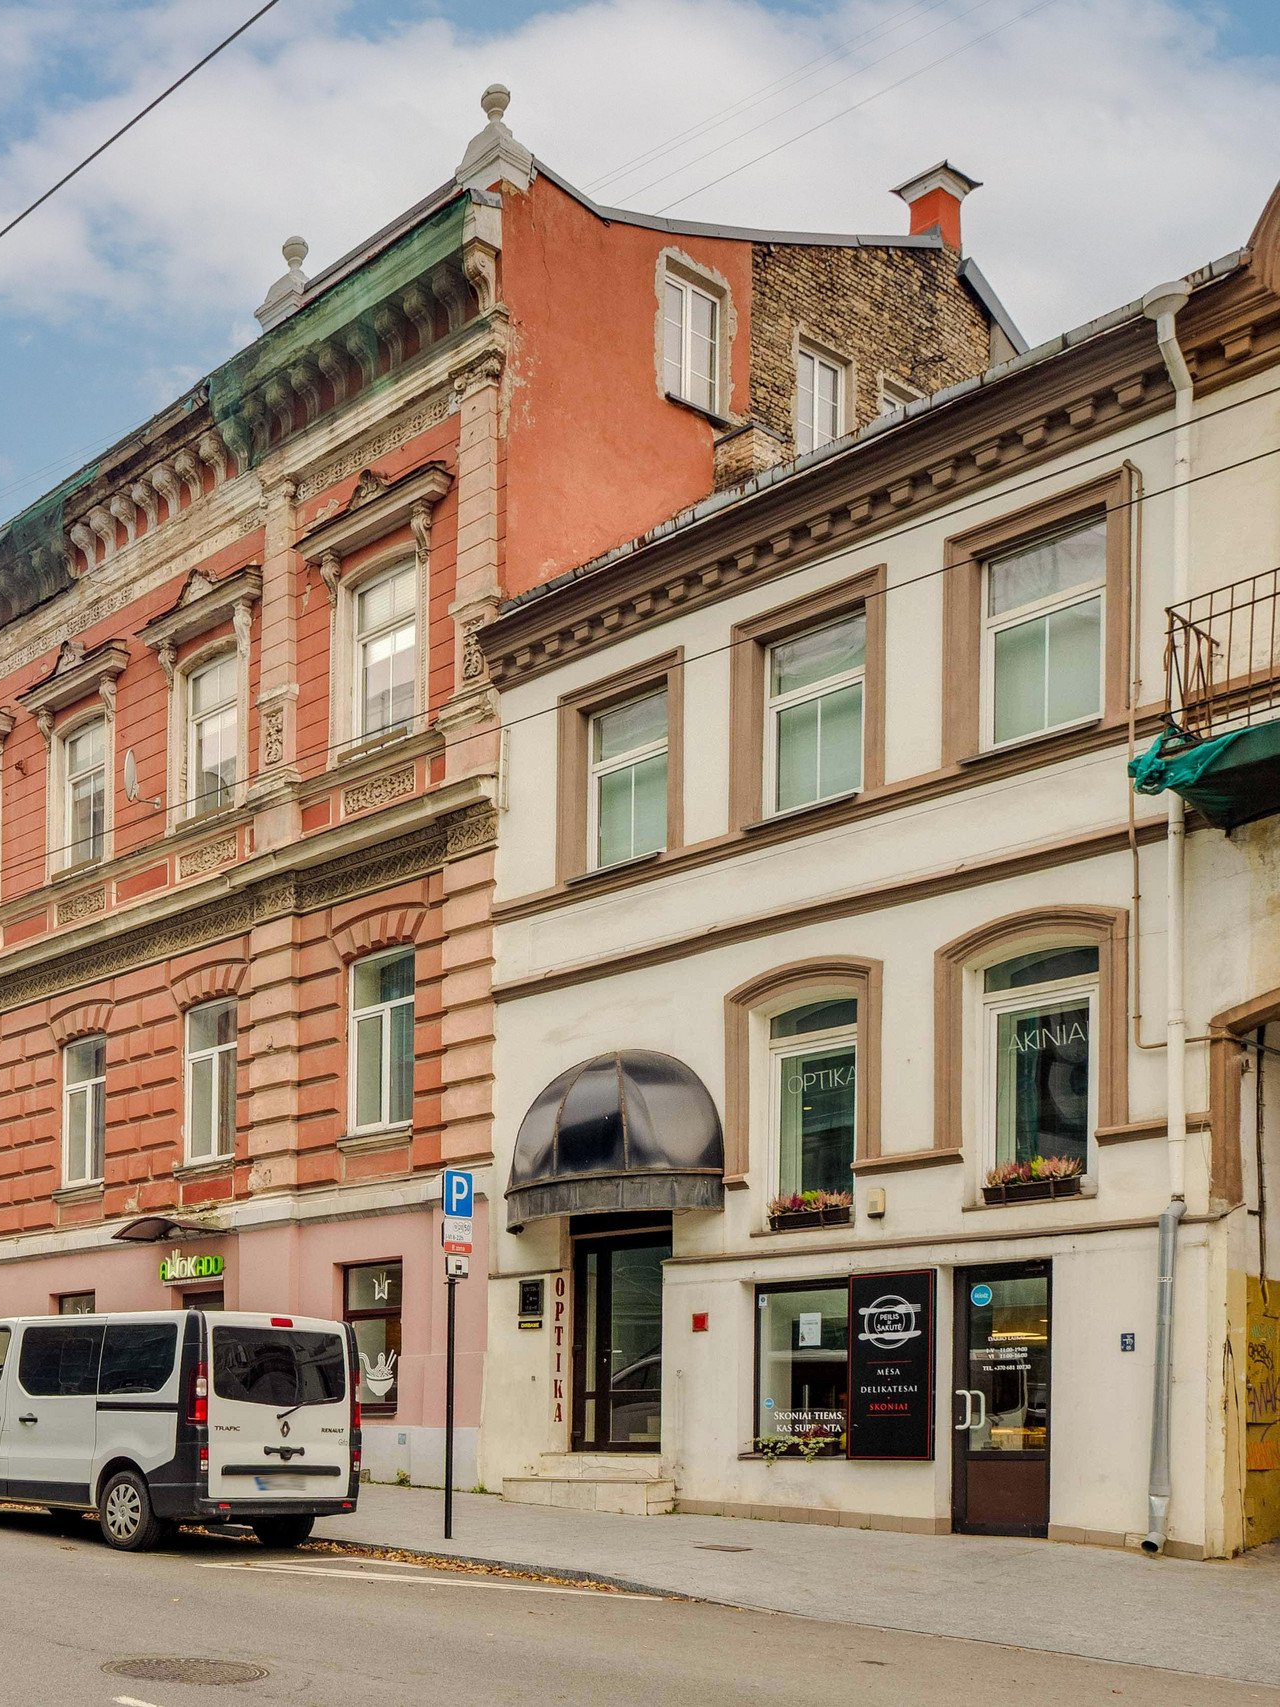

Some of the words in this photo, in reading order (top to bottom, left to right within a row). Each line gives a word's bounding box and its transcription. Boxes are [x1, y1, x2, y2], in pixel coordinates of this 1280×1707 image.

[452, 1175, 469, 1212] P
[880, 1313, 900, 1321] PEILIS
[554, 1277, 565, 1422] OPTIKA
[877, 1367, 900, 1376] MĖSA
[860, 1385, 918, 1393] DELIKATESAI
[773, 1411, 812, 1421] SKONIAI
[813, 1411, 845, 1421] TIEMS,
[776, 1424, 792, 1432] KAS
